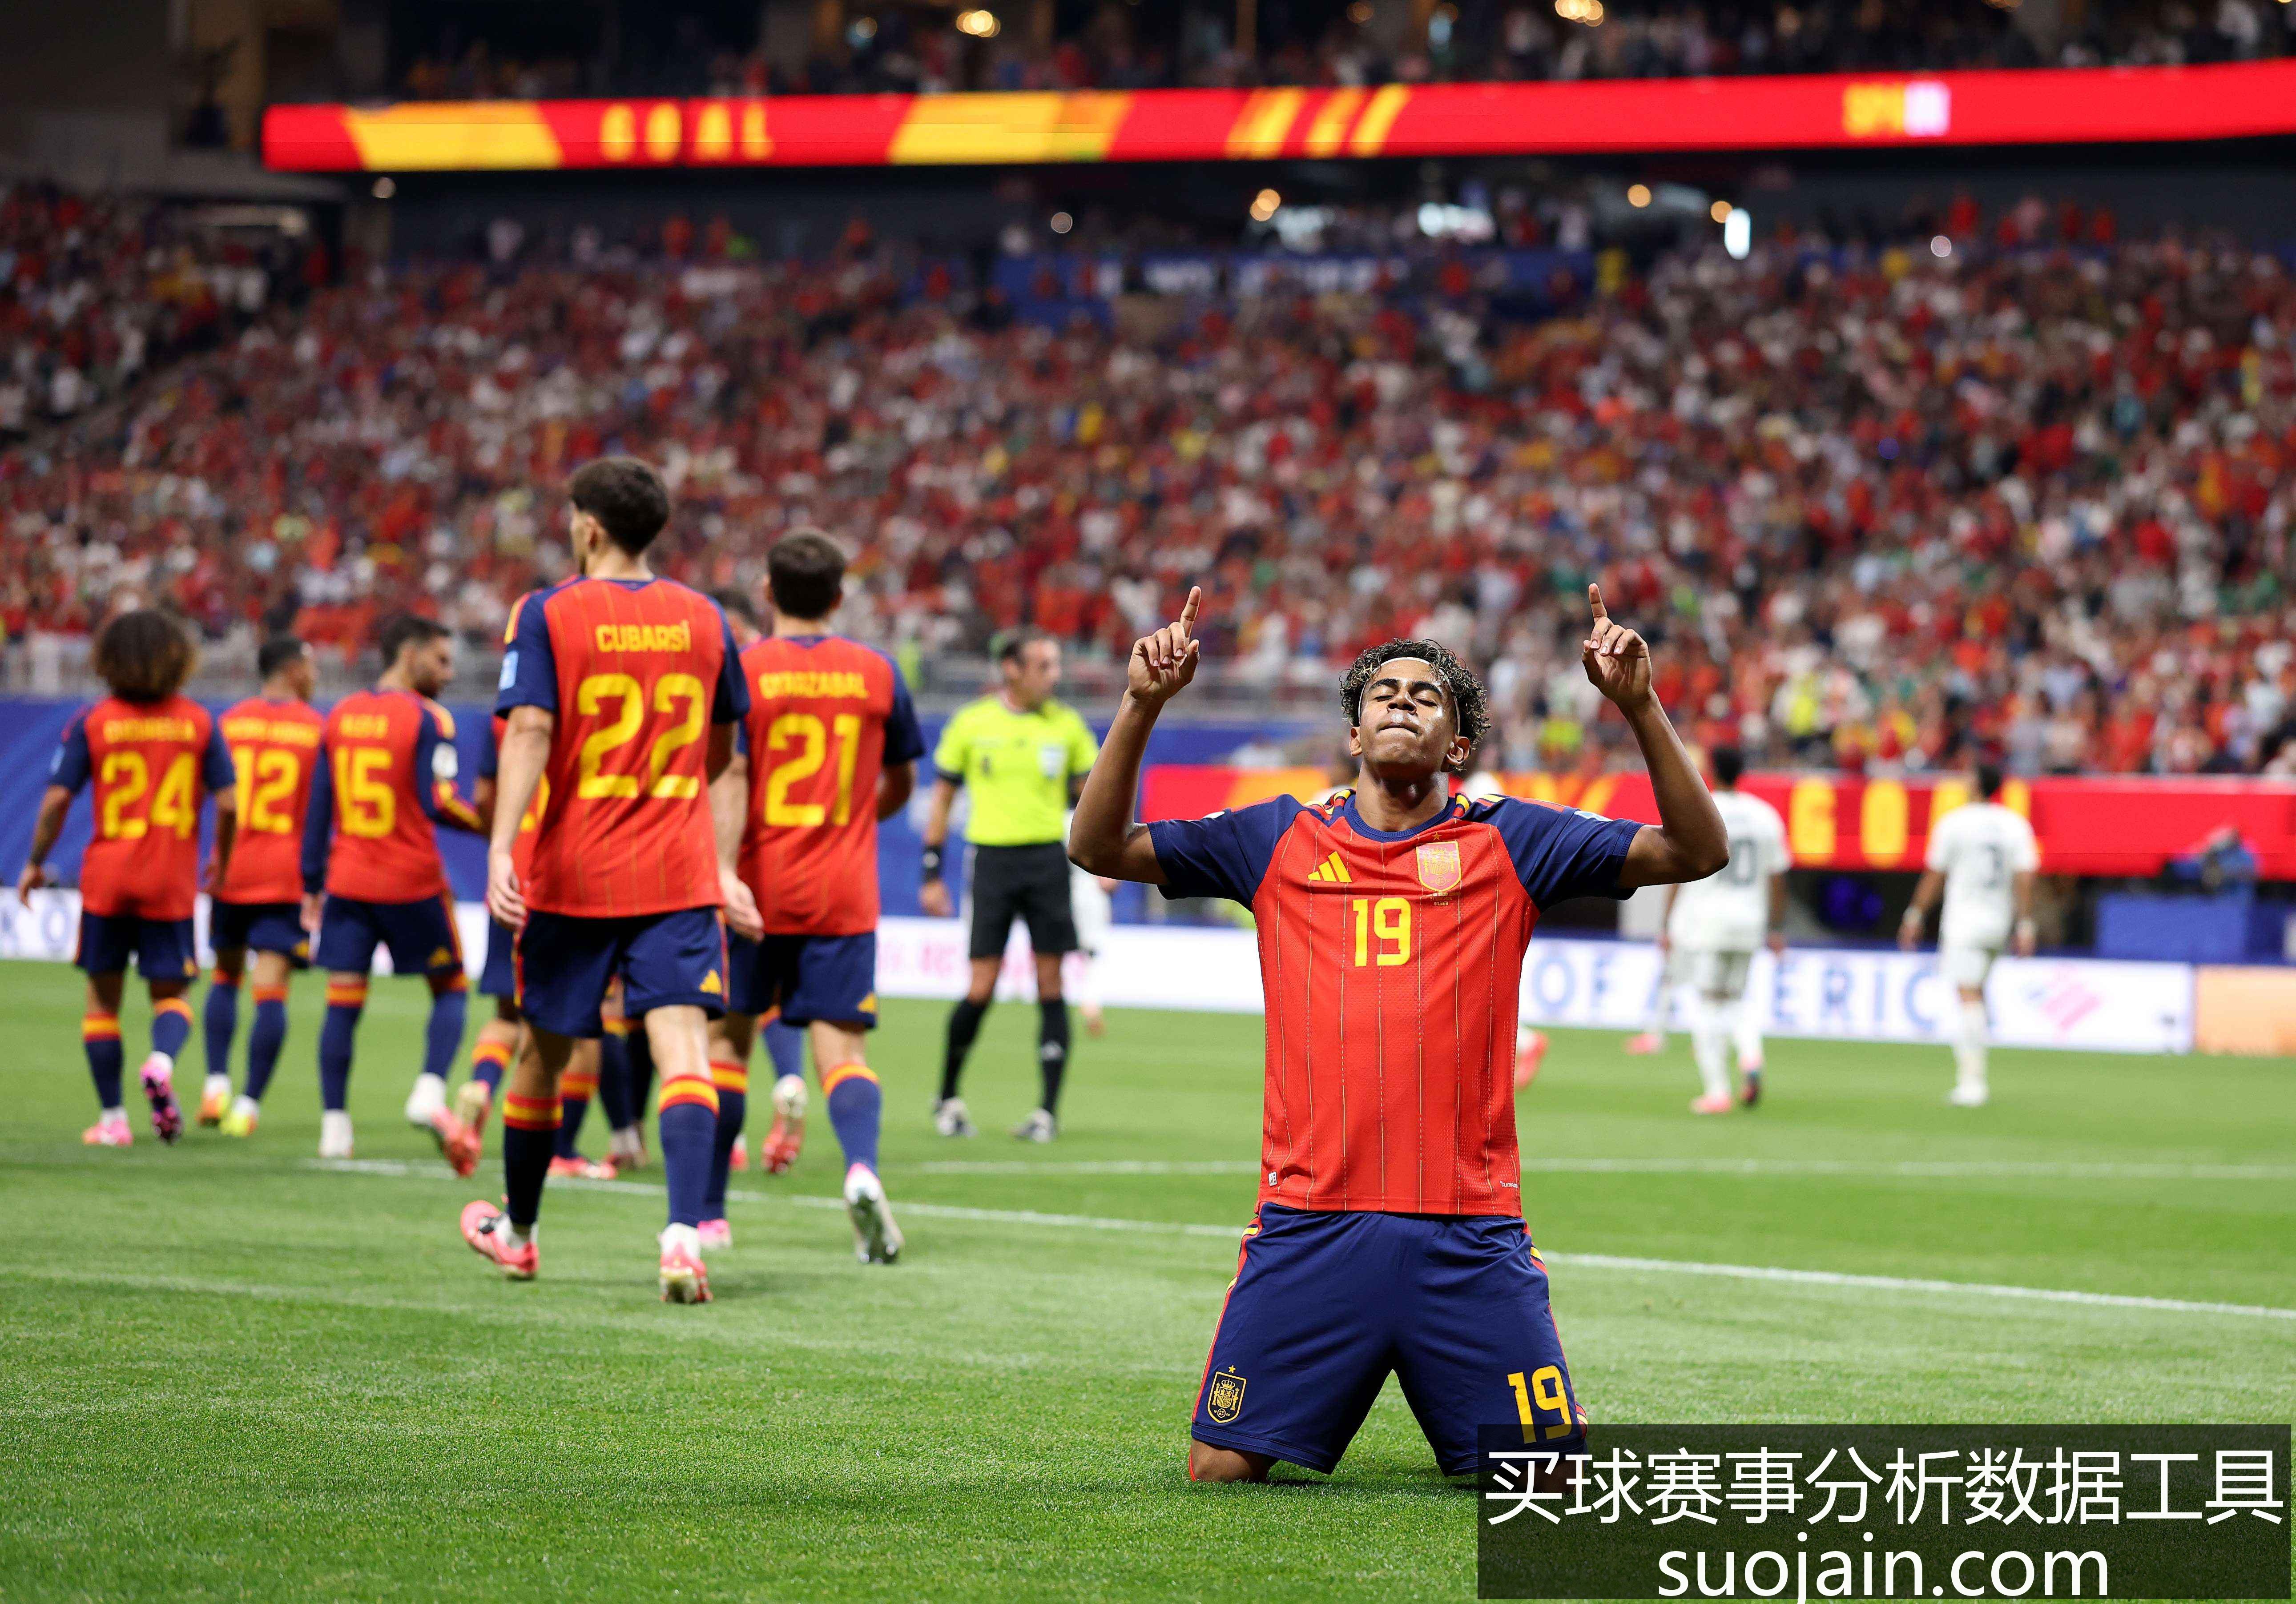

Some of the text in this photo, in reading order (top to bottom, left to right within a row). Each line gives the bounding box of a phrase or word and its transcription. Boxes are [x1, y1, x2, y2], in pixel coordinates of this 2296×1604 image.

[579, 673, 705, 799] 22
[765, 714, 861, 827] 21
[102, 752, 195, 839] 24
[232, 745, 300, 834] 12
[335, 745, 395, 838] 15
[1353, 897, 1411, 967] 19
[1507, 1365, 1572, 1444] 19
